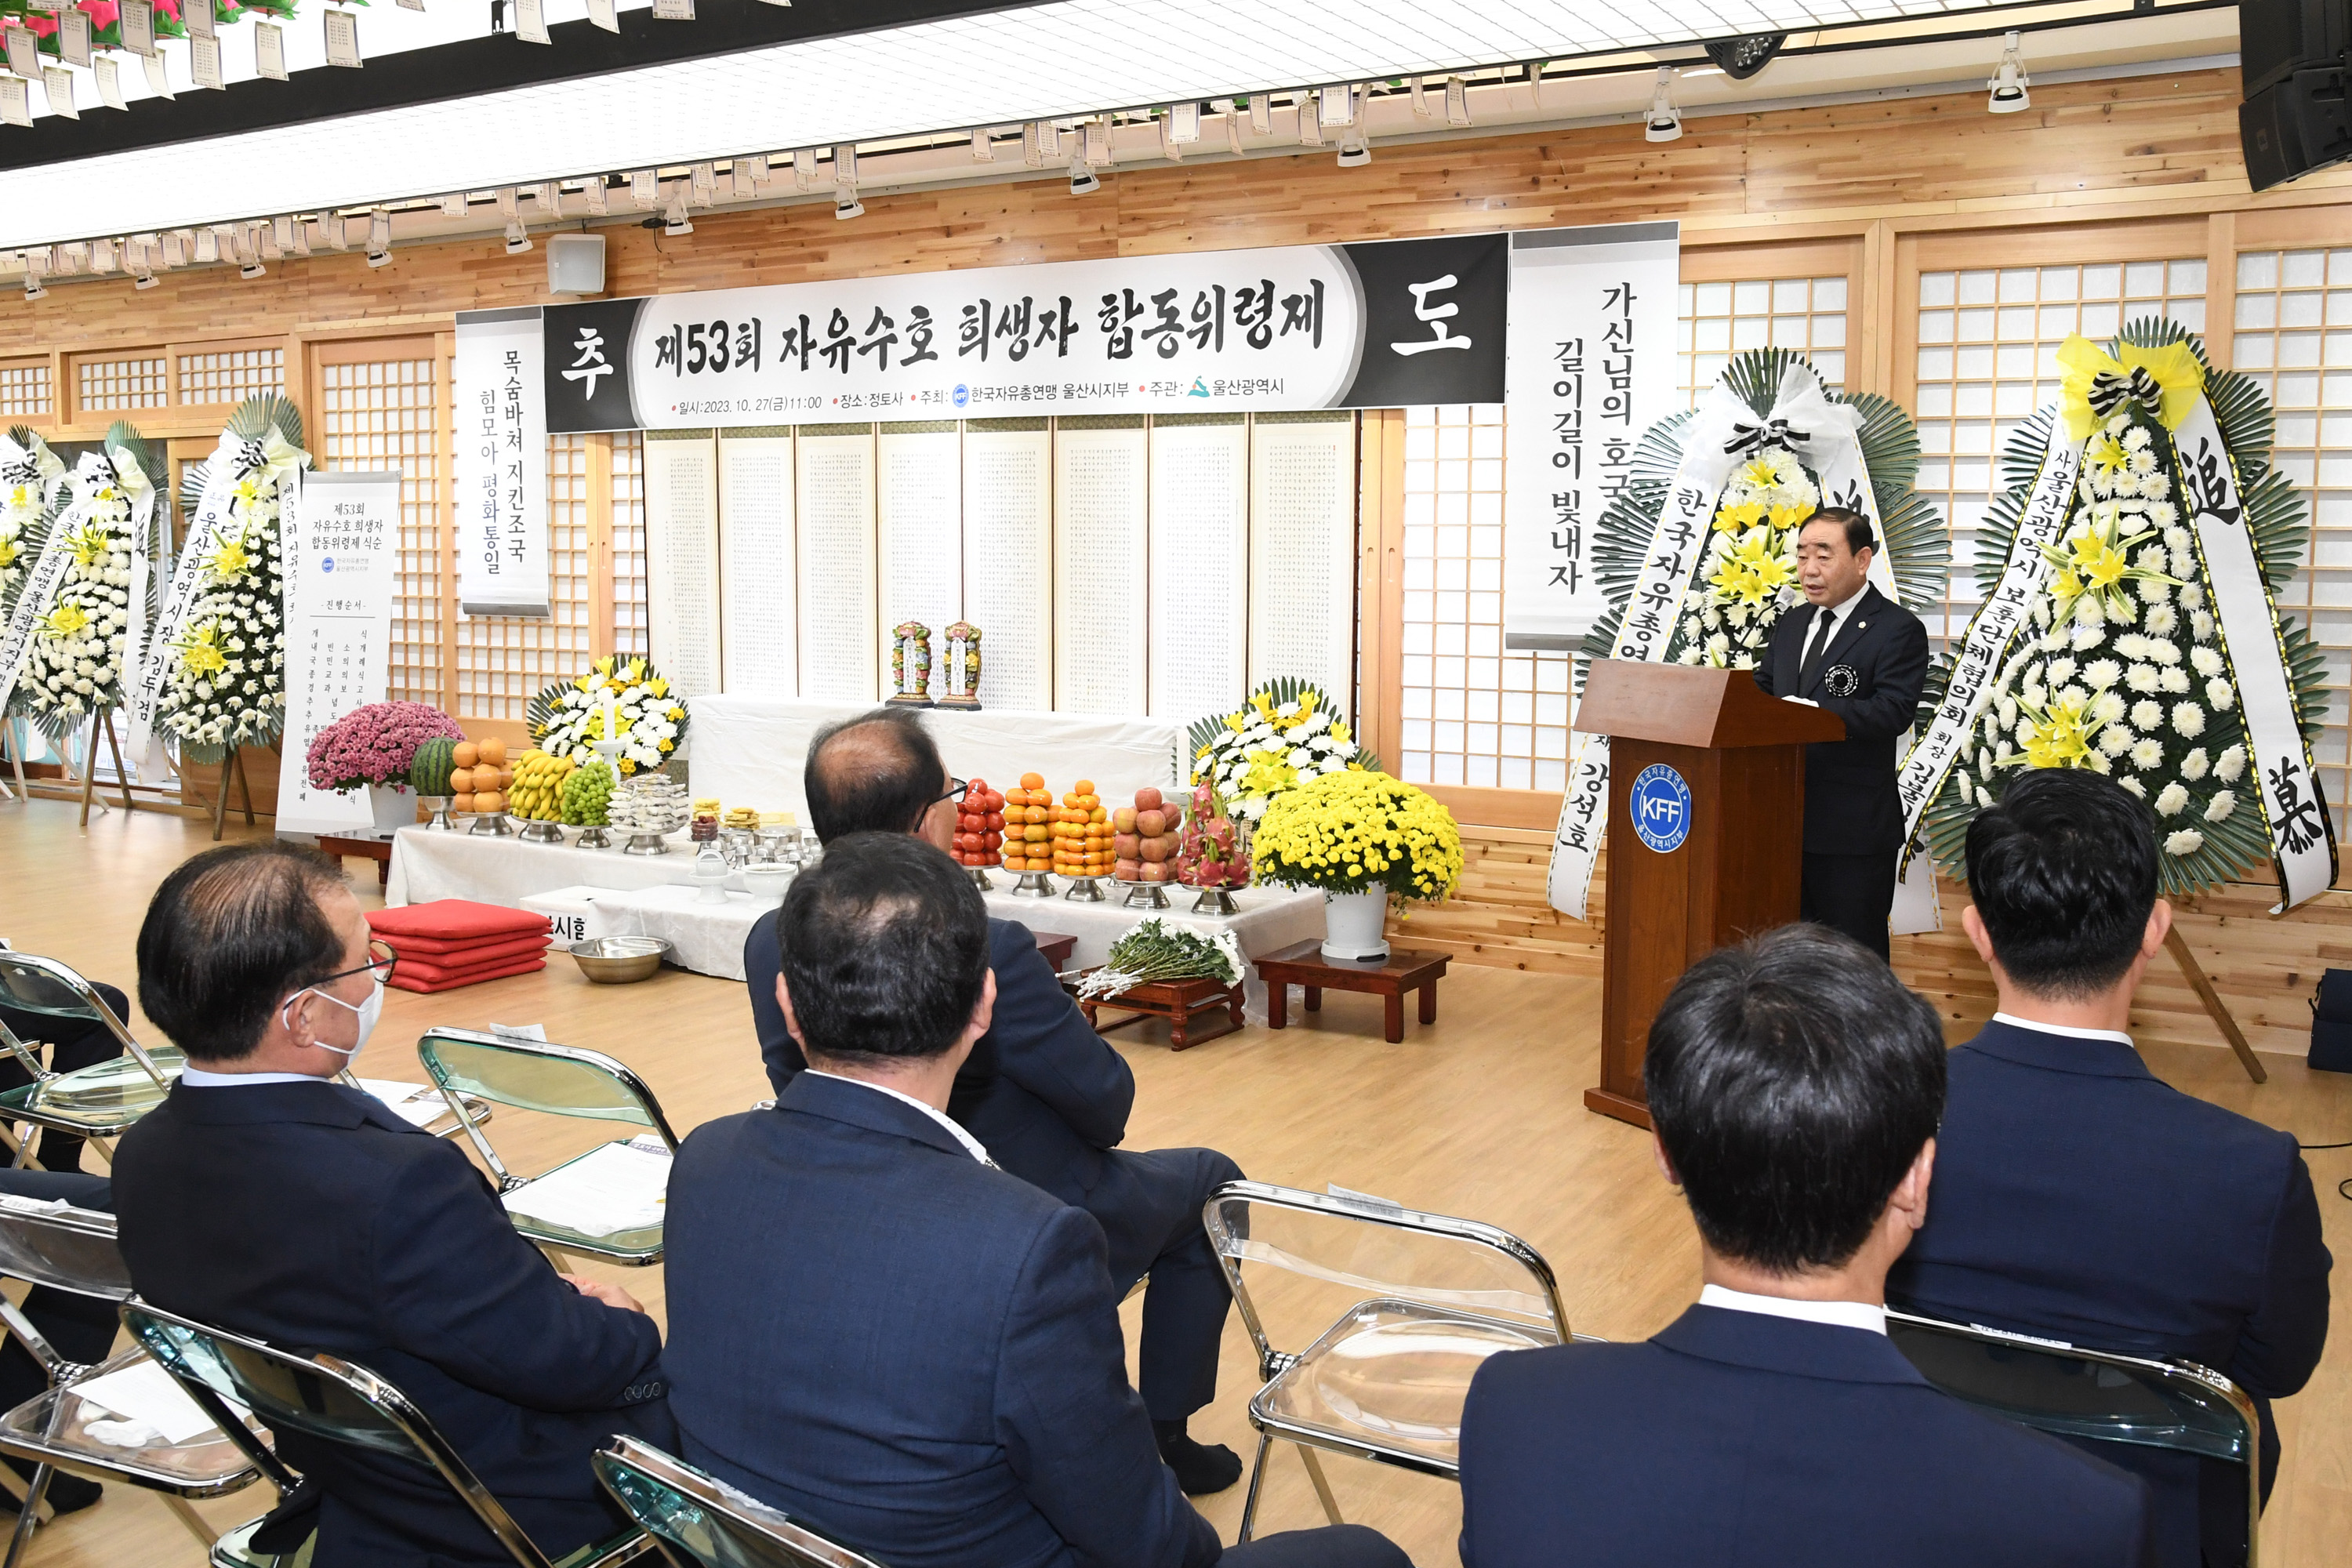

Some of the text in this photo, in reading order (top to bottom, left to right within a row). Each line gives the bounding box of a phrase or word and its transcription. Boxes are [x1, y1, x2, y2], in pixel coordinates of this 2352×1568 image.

[655, 278, 1324, 379] 제53회 자유수호 희생자 합동위령제
[1390, 274, 1472, 356] 도
[561, 327, 614, 401] 추
[1212, 377, 1284, 396] 울산광역시
[1600, 281, 1638, 426] 가신님의
[971, 382, 1130, 402] 한국자유총연맹 울산시지부
[1552, 338, 1584, 480] 길이길이
[480, 390, 500, 575] 힘모아 평화통일
[503, 350, 526, 563] 목숨바쳐 지킨조국
[2181, 437, 2241, 526] 追
[282, 483, 297, 536] 제53회
[312, 536, 382, 550] 합동위령제 식순
[313, 519, 383, 533] 자유수호 희생자
[334, 503, 365, 516] 제53회
[1548, 489, 1584, 595] 빛내자
[138, 655, 165, 721] 김두겸
[1940, 586, 2026, 728] 보훈단체협의회
[1638, 766, 1686, 794] 한국자유총연맹
[1926, 731, 1952, 759] 회장
[1560, 763, 1610, 854] 강석호
[1637, 824, 1683, 849] 울산광역시지부
[1642, 795, 1680, 822] KFF
[2268, 756, 2324, 855] 慕
